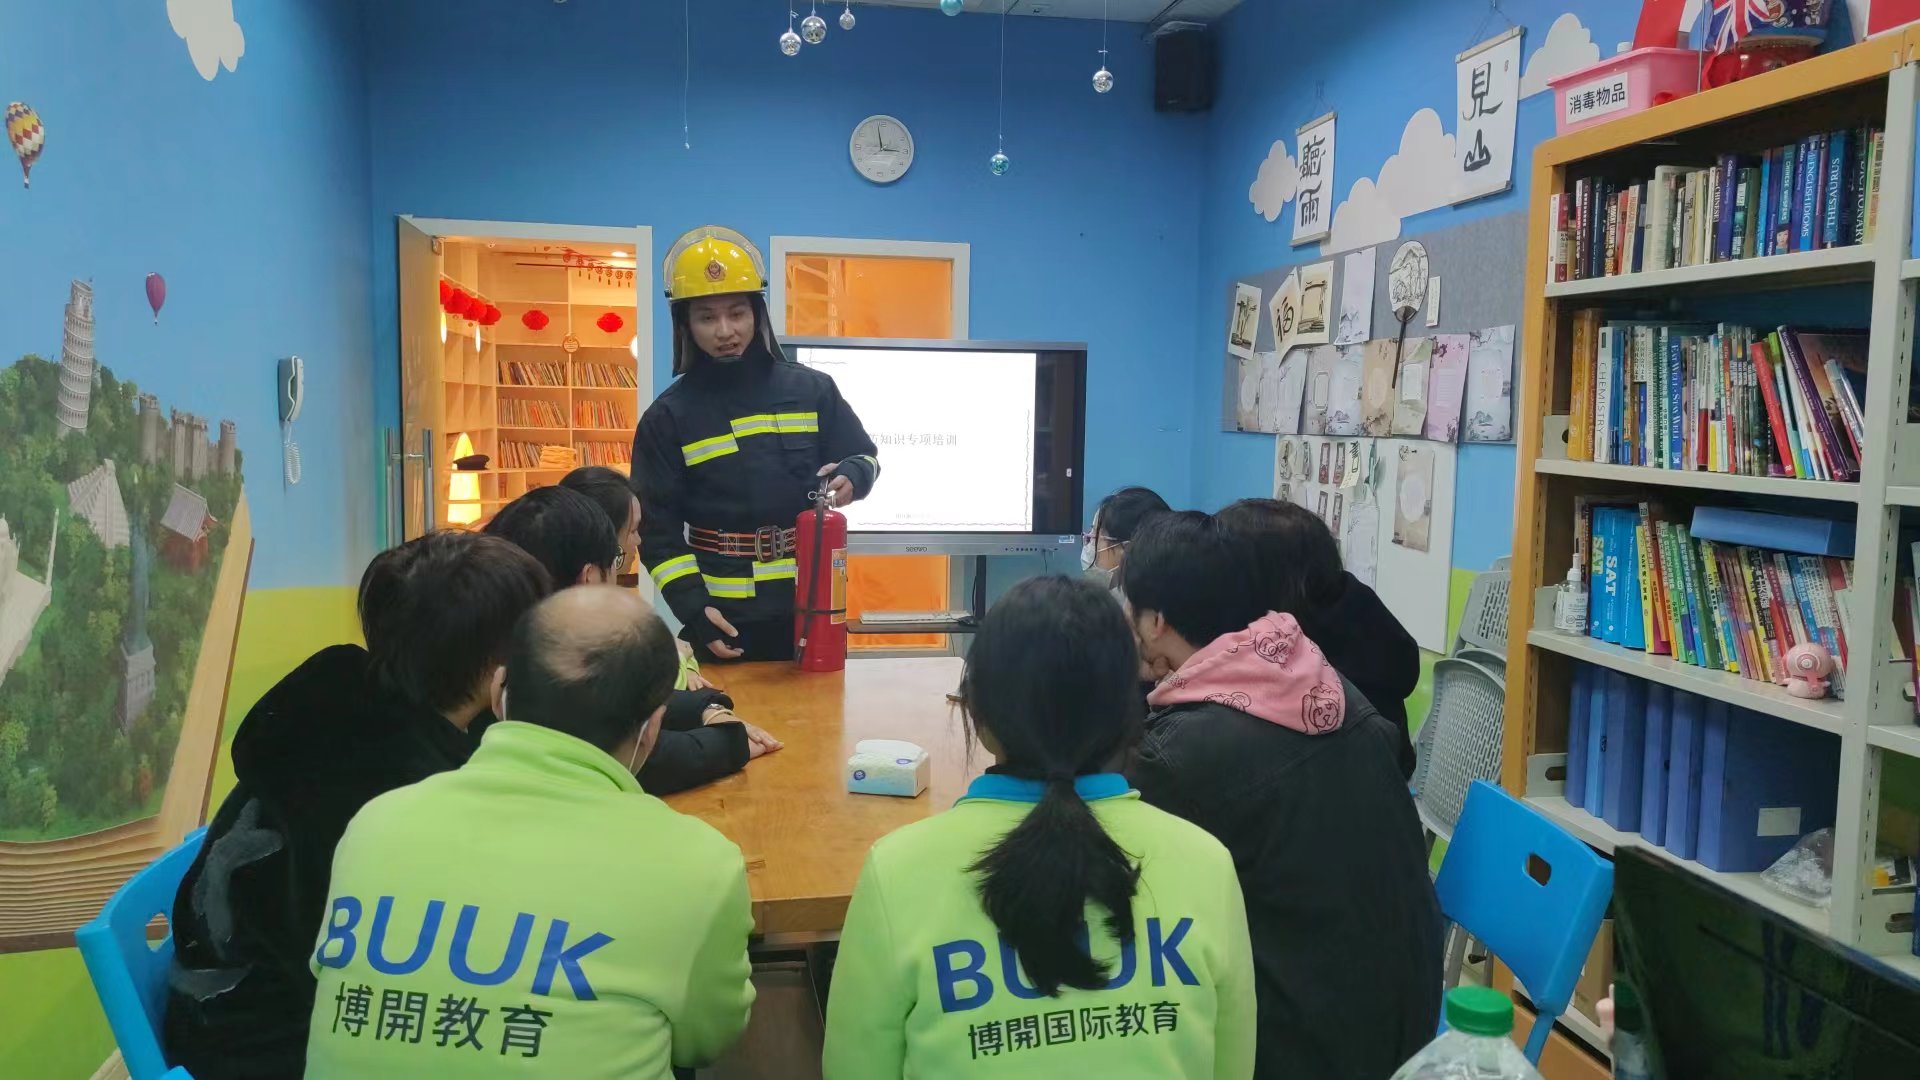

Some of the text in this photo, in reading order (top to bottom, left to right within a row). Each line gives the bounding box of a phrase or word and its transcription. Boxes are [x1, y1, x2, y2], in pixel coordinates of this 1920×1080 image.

[1462, 61, 1503, 173] 見山
[1568, 82, 1626, 115] 消毒物品
[1713, 186, 1721, 220] CHINESE
[1801, 161, 1817, 237] ENGLISH IDIOMS
[1827, 158, 1840, 229] THESAURUS
[1597, 362, 1607, 434] CHEMISTRY
[1592, 536, 1604, 575] SAT
[1605, 555, 1618, 597] SAT
[316, 895, 615, 1001] BUUK
[332, 981, 553, 1059] 博開教育
[967, 1001, 1181, 1060] 博開国际教育
